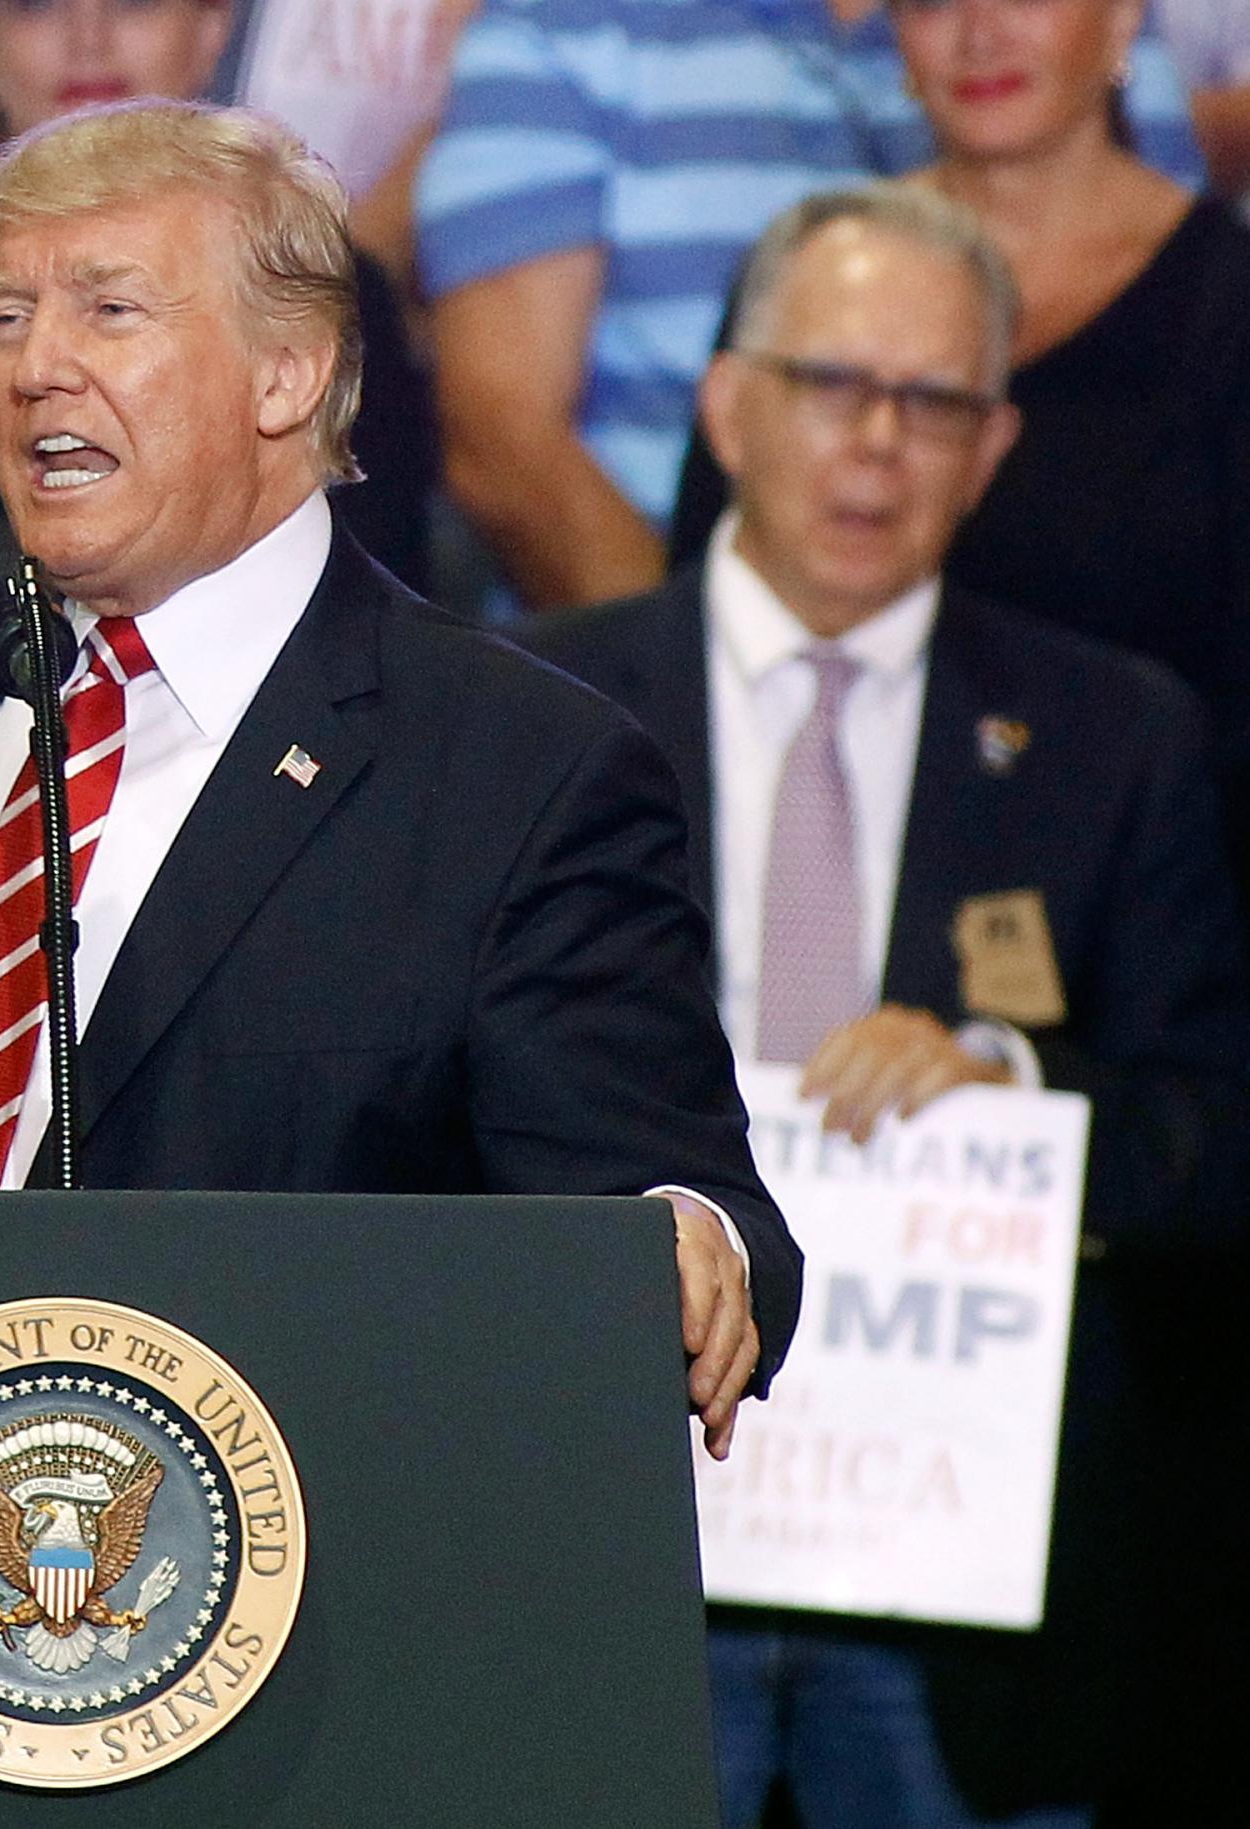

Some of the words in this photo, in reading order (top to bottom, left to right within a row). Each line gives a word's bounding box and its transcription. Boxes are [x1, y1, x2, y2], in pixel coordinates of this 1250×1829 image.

[900, 1199, 1048, 1269] FOR
[70, 1323, 115, 1353] OF
[124, 1335, 184, 1383] THE
[820, 1271, 1044, 1367] MP
[193, 1378, 288, 1578] UNITED
[100, 1621, 264, 1765] STATES
